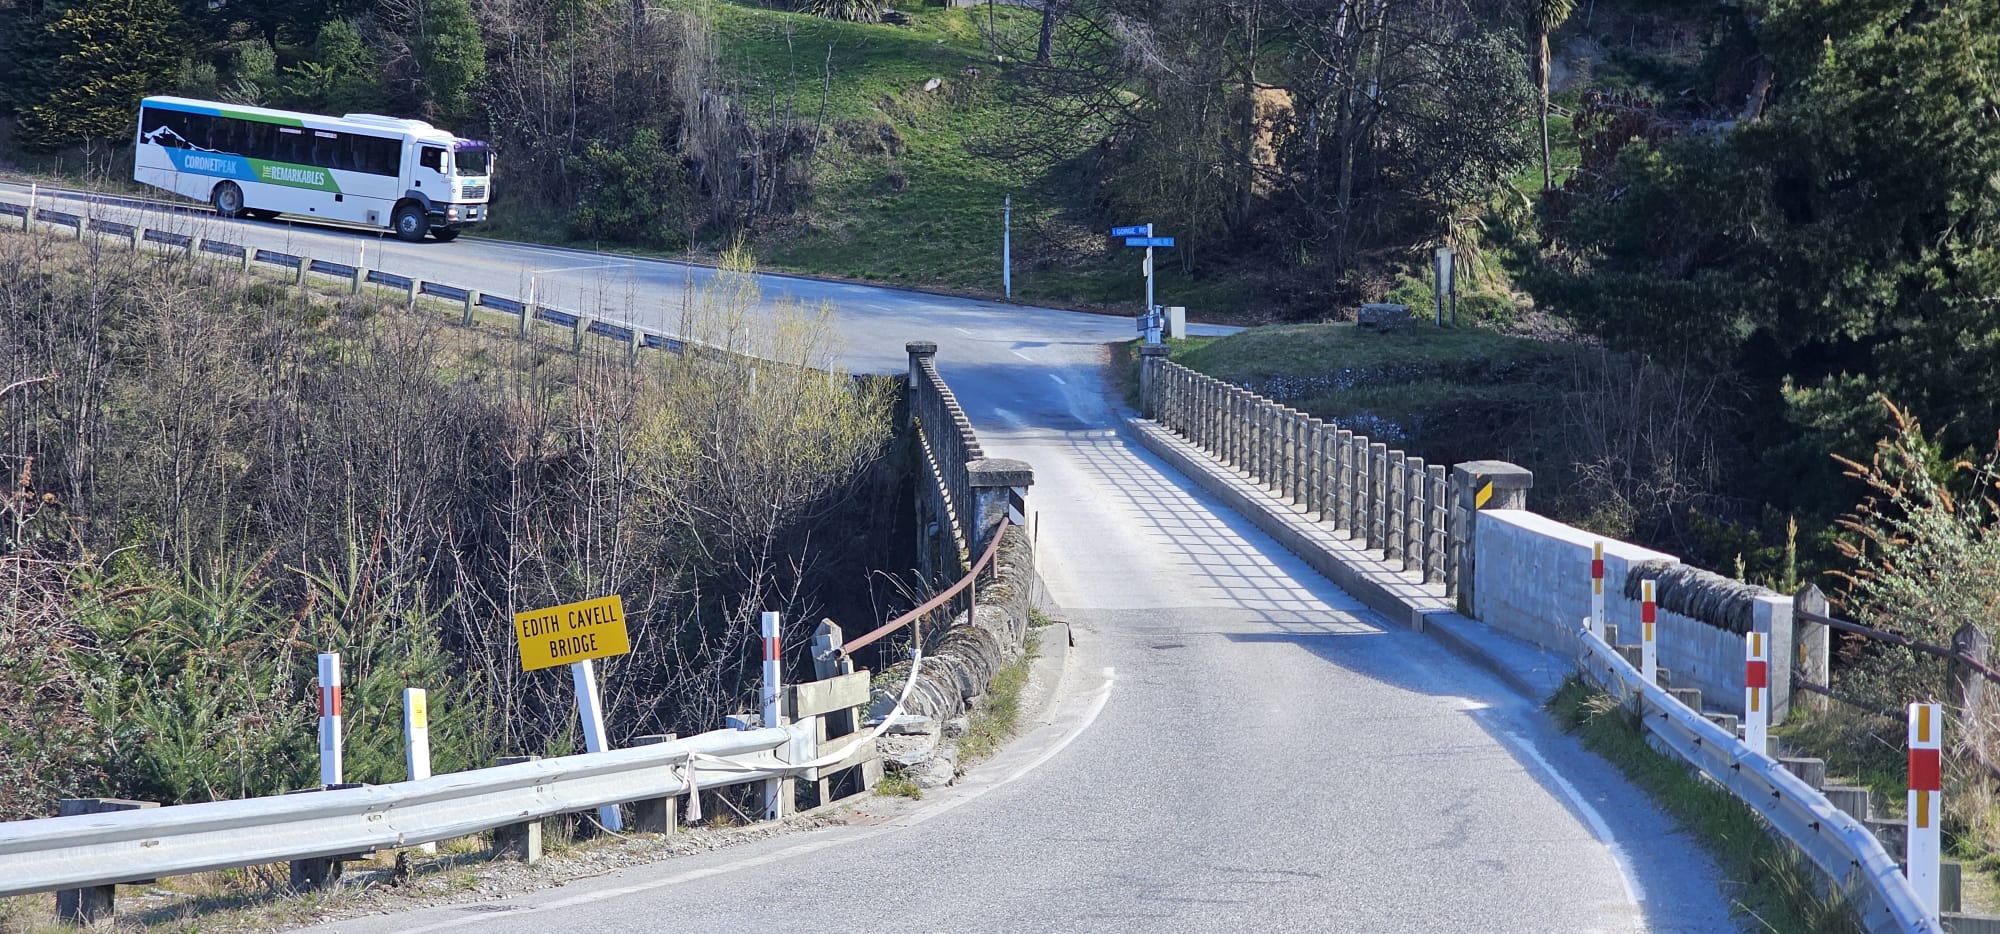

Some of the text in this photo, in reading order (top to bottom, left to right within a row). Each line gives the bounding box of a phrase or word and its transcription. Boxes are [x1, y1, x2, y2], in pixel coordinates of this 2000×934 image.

[262, 165, 325, 185] THE REMARKABLES
[522, 605, 617, 637] EDITH CAVELL
[550, 634, 598, 658] BRIDGE
